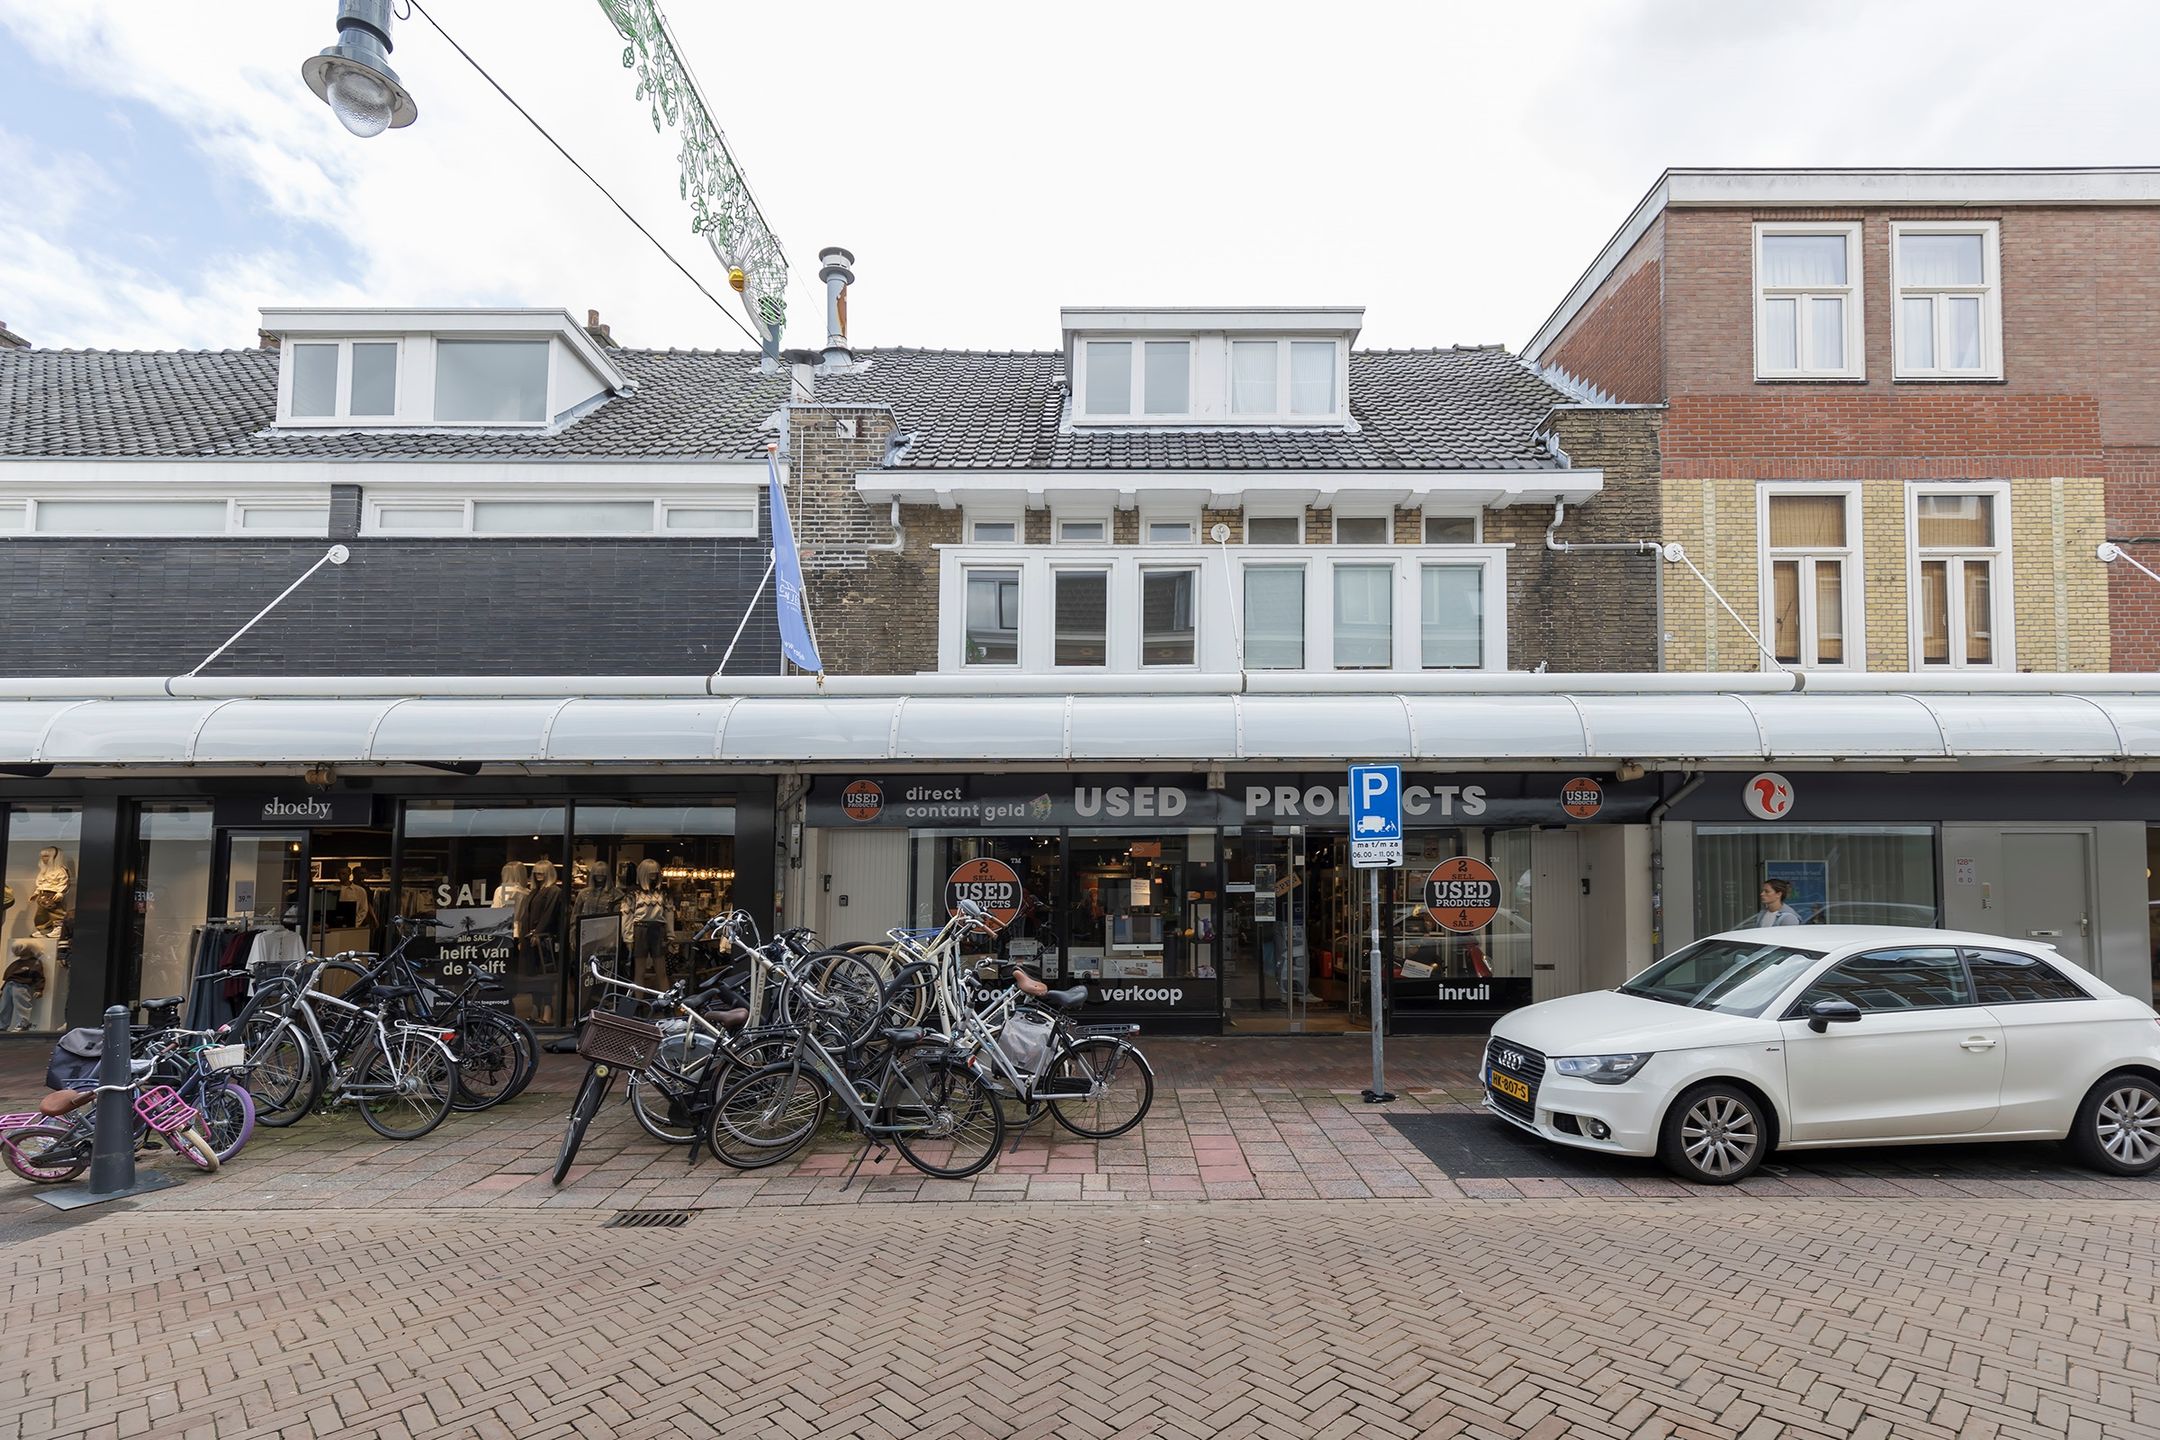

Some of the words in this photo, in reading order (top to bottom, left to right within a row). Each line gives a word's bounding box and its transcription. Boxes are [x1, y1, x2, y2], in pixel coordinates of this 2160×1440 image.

[847, 793, 879, 804] USED
[905, 786, 962, 801] direct
[1363, 772, 1388, 810] P
[1566, 790, 1598, 801] USED
[264, 796, 332, 819] shoeby
[1075, 786, 1187, 817] USED
[1246, 785, 1488, 816] PROCTS
[905, 804, 980, 817] contant
[984, 803, 1025, 821] geld
[1371, 841, 1387, 849] t/m
[1352, 851, 1372, 859] 06.00
[979, 861, 990, 874] 2
[1458, 860, 1468, 873] 2
[972, 874, 996, 882] SELL
[954, 882, 1013, 900] USED
[1433, 881, 1493, 899] USED
[1435, 898, 1491, 908] PRODUCTS
[1458, 909, 1467, 921] 4
[458, 934, 472, 943] alle
[473, 933, 494, 942] SALE
[440, 945, 479, 961] helft
[482, 947, 510, 959] van
[442, 961, 464, 976] de
[1100, 984, 1184, 1006] verkoop
[1438, 983, 1491, 1001] inruil
[1493, 1072, 1527, 1099] HK-807-S
